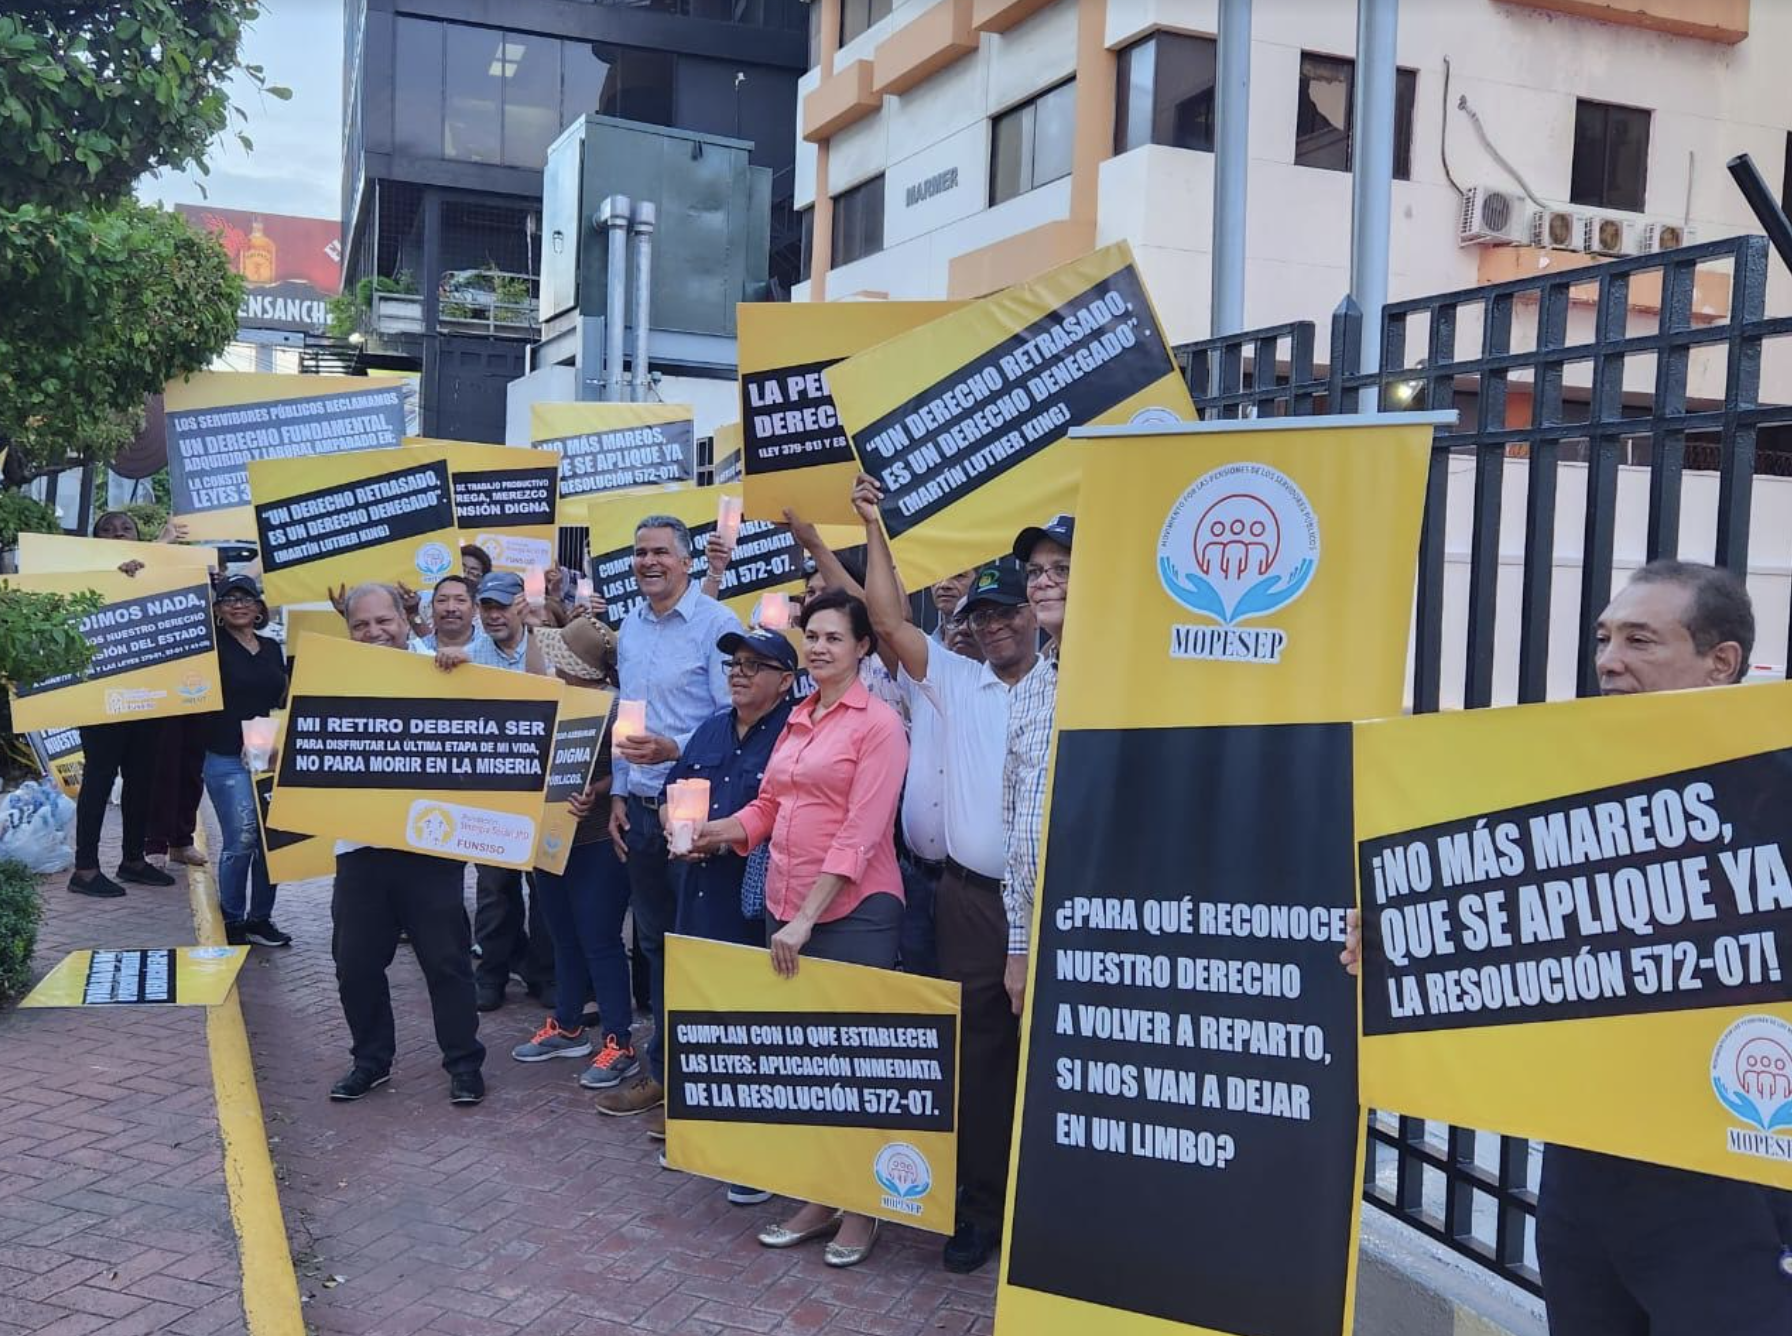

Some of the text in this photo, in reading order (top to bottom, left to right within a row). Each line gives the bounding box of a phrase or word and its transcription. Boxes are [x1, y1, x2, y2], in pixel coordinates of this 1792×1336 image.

[866, 291, 1133, 457] “UN DERECHO RETRASADO,
[749, 380, 783, 407] LA
[175, 392, 398, 432] LOS SERVIDORES PÚBLICOS RECLAMAMOS
[179, 438, 204, 456] UN
[206, 428, 280, 452] DERECHO
[184, 451, 250, 472] ADQUIRIDO
[252, 449, 260, 460] Y
[262, 445, 312, 460] LABORAL
[314, 434, 377, 455] AMPARADO
[566, 434, 600, 455] MÁS
[602, 428, 666, 450] MAREOS,
[758, 446, 779, 458] (LEY
[824, 439, 831, 448] Y
[882, 462, 912, 492] ES
[907, 442, 941, 474] UN
[936, 388, 1030, 457] DERECHO
[575, 456, 594, 474] SE
[597, 446, 662, 471] APLIQUE
[665, 443, 683, 461] YA
[898, 402, 1071, 516] (MARTÍN LUTHER KING)
[188, 479, 202, 490] LA
[291, 491, 355, 519] DERECHO
[356, 470, 440, 503] RETRASADO,
[468, 481, 500, 490] TRABAJO
[502, 479, 548, 489] PRODUCTIVO
[561, 465, 679, 494] RESOLUCIÓN 572-07!
[192, 486, 237, 507] LEYES
[456, 490, 547, 503] REGA, MEREZCO
[457, 502, 550, 516] NSIÓN DIGNA
[268, 530, 285, 546] ES
[287, 524, 307, 542] UN
[309, 509, 368, 537] DERECHO
[274, 525, 390, 564] (MARTÍN LUTHER KING)
[603, 581, 624, 598] LAS
[624, 576, 638, 592] LE
[608, 602, 626, 622] DE
[739, 555, 795, 583] 572-07.
[79, 593, 206, 632] DIMOS NADA,
[106, 624, 156, 641] NUESTRO
[158, 612, 205, 629] DERECHO
[92, 643, 128, 661] SIÓN
[131, 637, 155, 651] DEL
[158, 626, 206, 645] ESTADO
[1173, 628, 1283, 659] MOPESEP
[297, 718, 320, 732] MI
[327, 718, 403, 733] RETIRO
[410, 718, 499, 734] DEBERÍA
[505, 721, 545, 735] SER
[44, 730, 82, 755] NUESTR
[296, 738, 539, 755] PARA DISFRUTAR LA ÚLTIMA ETAPA DE MI VIDA,
[555, 747, 590, 764] DIGNA
[296, 755, 541, 774] NO PARA MORIR EN LA MISERIA
[457, 839, 505, 854] FUNSISO
[1372, 782, 1733, 904] ¡NO MÁS MAREOS,
[1056, 896, 1348, 942] ¿PARA QUÉ RECONOCE
[1380, 843, 1792, 966] QUE SE APLIQUE YA
[1057, 950, 1300, 999] NUESTRO DERECHO
[1388, 931, 1782, 1018] LA RESOLUCIÓN 572-07!
[677, 1024, 938, 1049] CUMPLAN CON LO QUE ESTABLECEN
[1057, 1004, 1332, 1065] A VOLVER A REPARTO,
[680, 1054, 942, 1080] LAS LEYES: APLICACIÓN INMEDIATA
[684, 1082, 940, 1116] DE LA RESOLUCIÓN 572-07.
[1057, 1058, 1311, 1120] SI NOS VAN A DEJAR
[1057, 1112, 1235, 1168] EN UN LIMBO?
